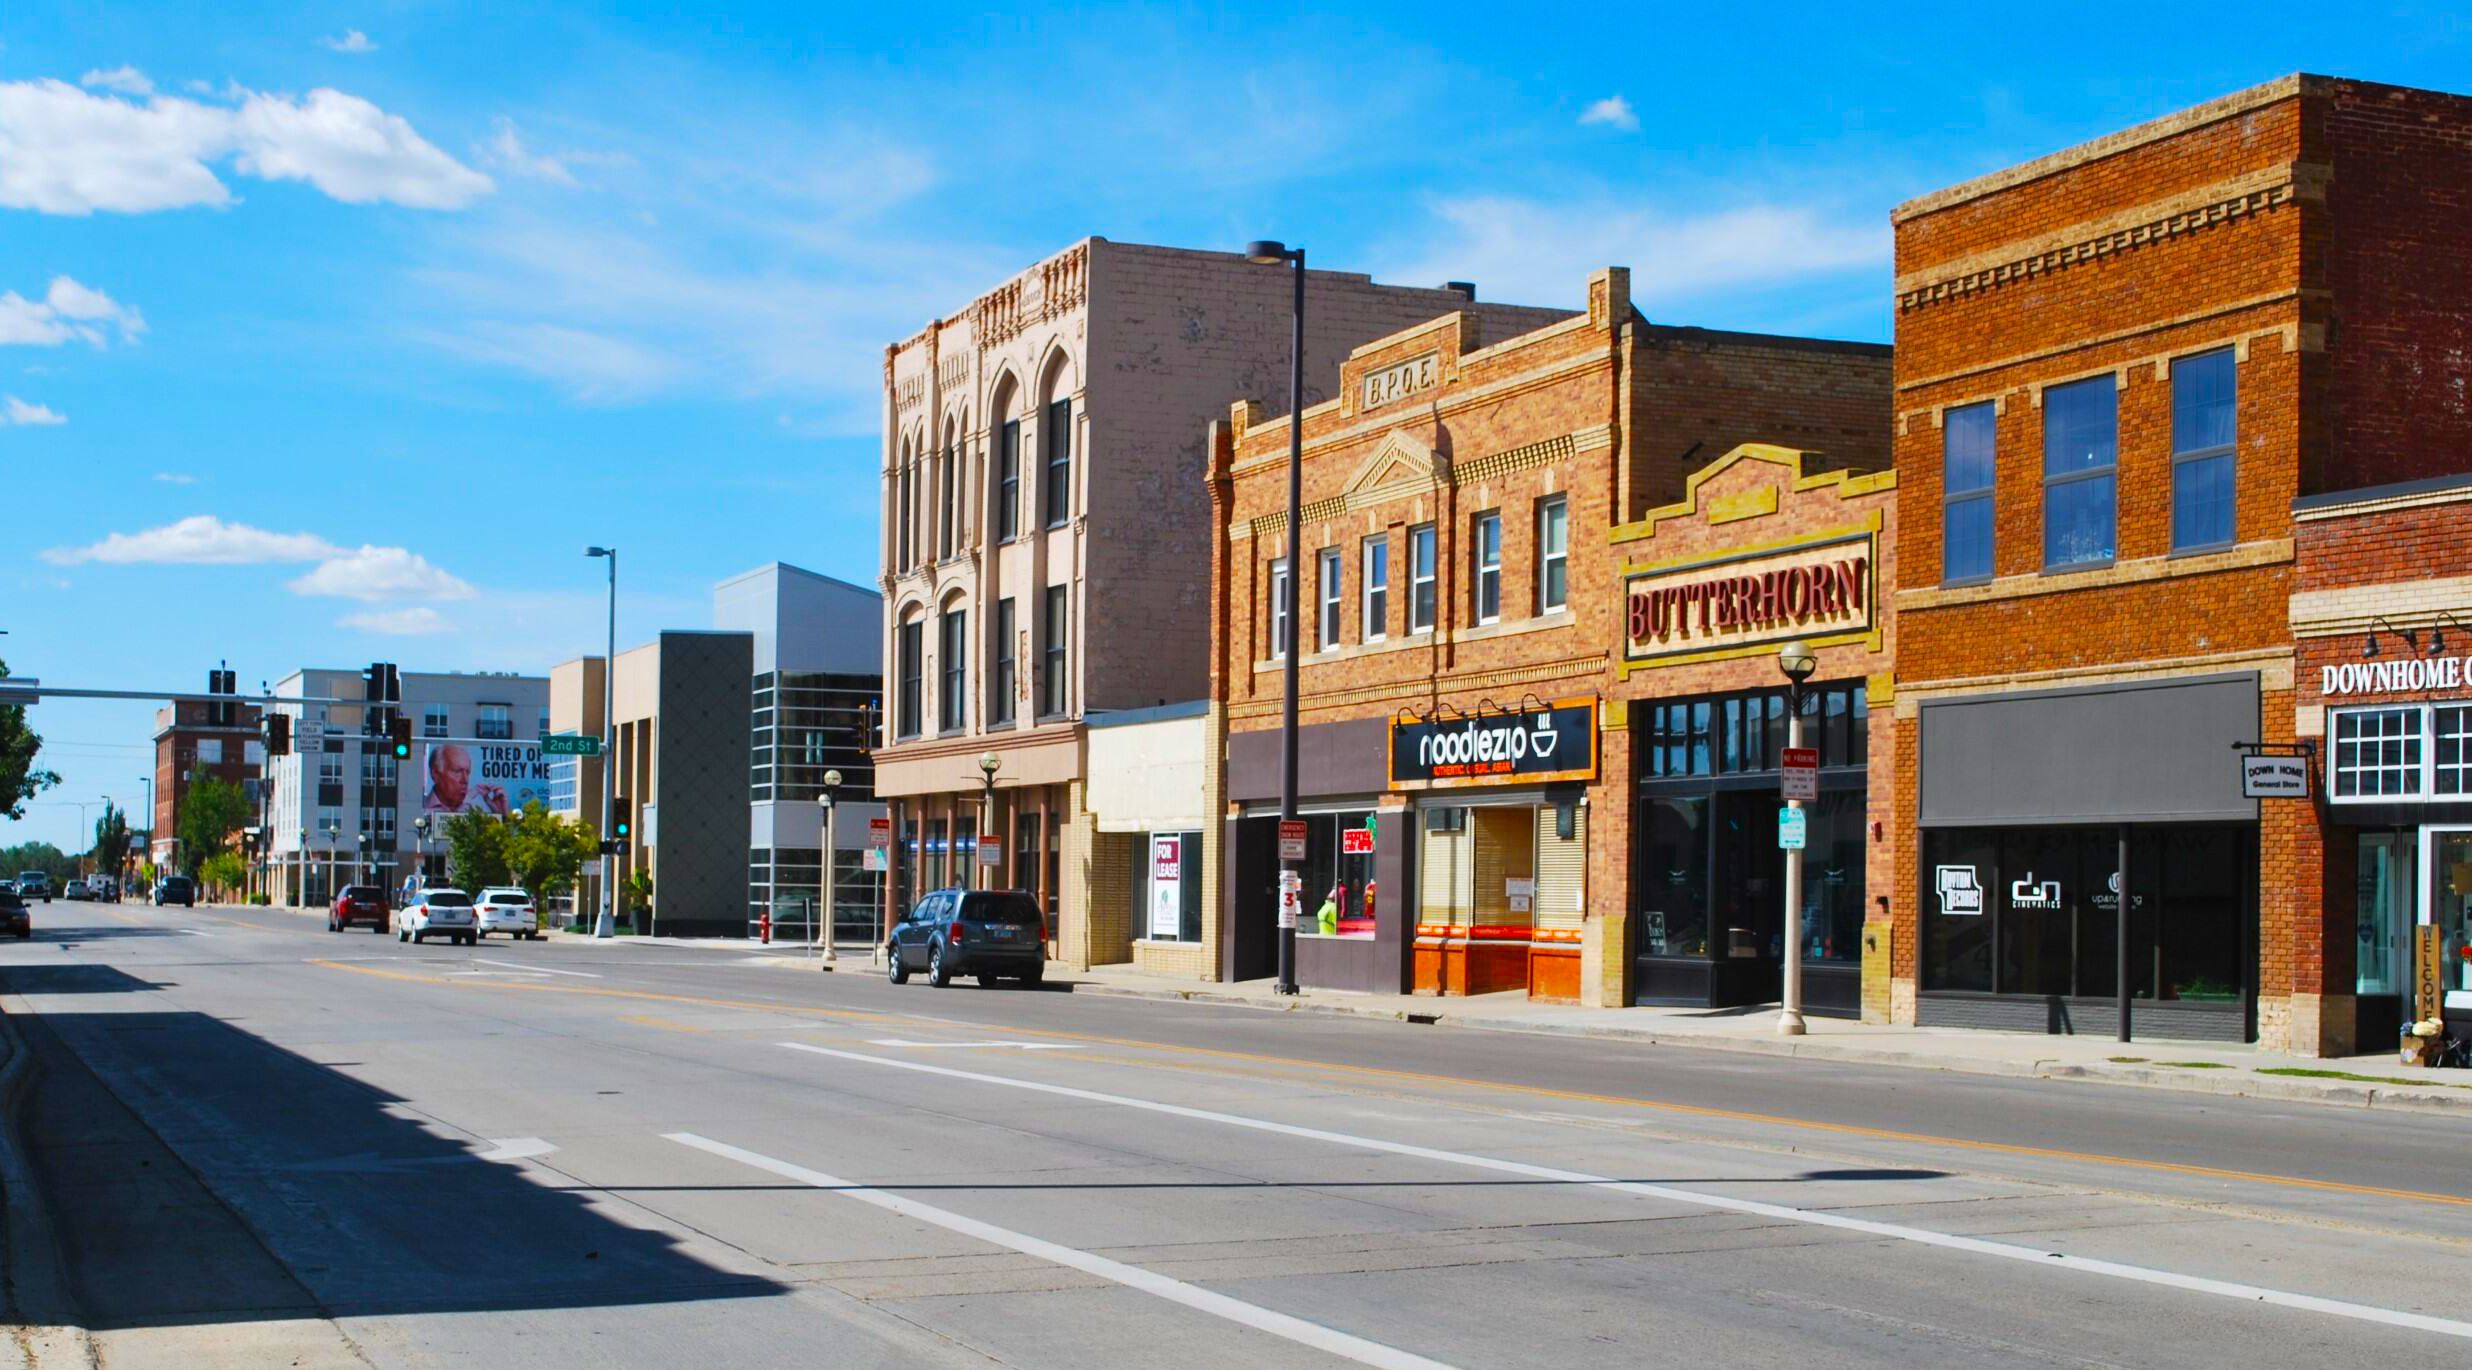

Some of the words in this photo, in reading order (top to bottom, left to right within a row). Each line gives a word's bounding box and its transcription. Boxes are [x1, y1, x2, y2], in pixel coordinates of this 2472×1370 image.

[1627, 557, 1866, 638] BUTTERHORN
[2321, 656, 2461, 695] DOWNHOME
[550, 740, 573, 751] 2nd
[577, 740, 591, 752] St
[1420, 720, 1528, 768] noodlezip
[481, 746, 521, 761] TIRED
[482, 761, 527, 779] GOOEY
[2248, 765, 2274, 778] DOWN
[2280, 765, 2304, 778] HOME
[2252, 780, 2281, 788] General
[1157, 844, 1173, 859] FOR
[1157, 862, 1178, 878] LEASE
[1284, 892, 1294, 907] 3
[2012, 900, 2061, 909] CINEMATICS
